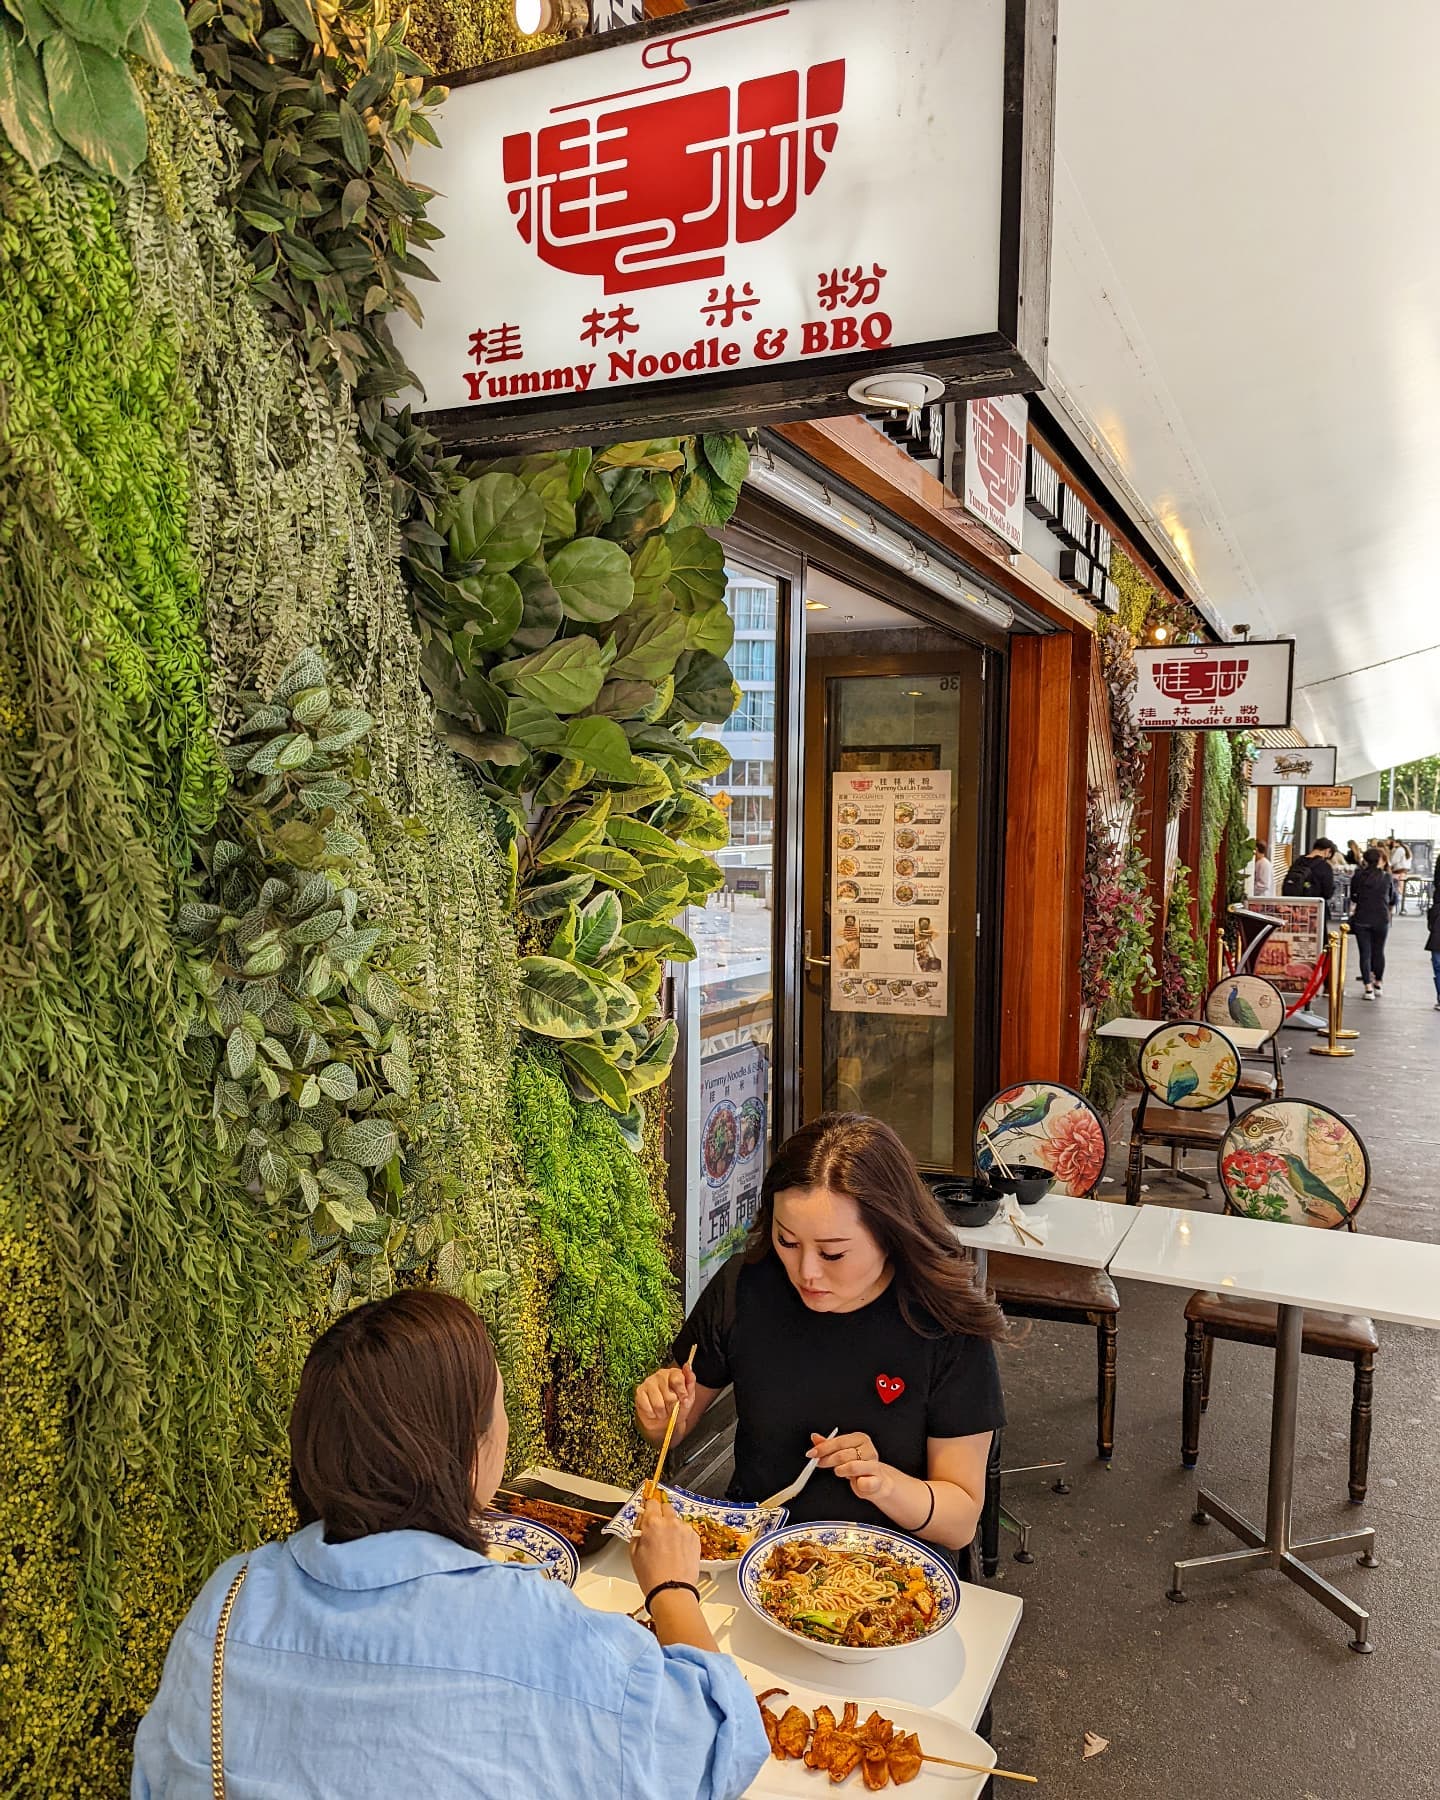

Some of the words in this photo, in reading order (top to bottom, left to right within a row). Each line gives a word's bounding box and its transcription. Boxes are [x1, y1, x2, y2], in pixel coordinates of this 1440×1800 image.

[463, 361, 597, 402] Yummy
[608, 337, 740, 383] Noodle
[753, 328, 788, 360] &
[800, 311, 892, 355] BBQ
[1137, 716, 1178, 727] Yummy
[1181, 717, 1220, 726] Noodle
[1223, 715, 1232, 724] &
[1235, 715, 1260, 725] BBQ
[874, 784, 896, 792] Yummy
[704, 1076, 727, 1090] Yummy
[727, 1066, 747, 1081] Noodle
